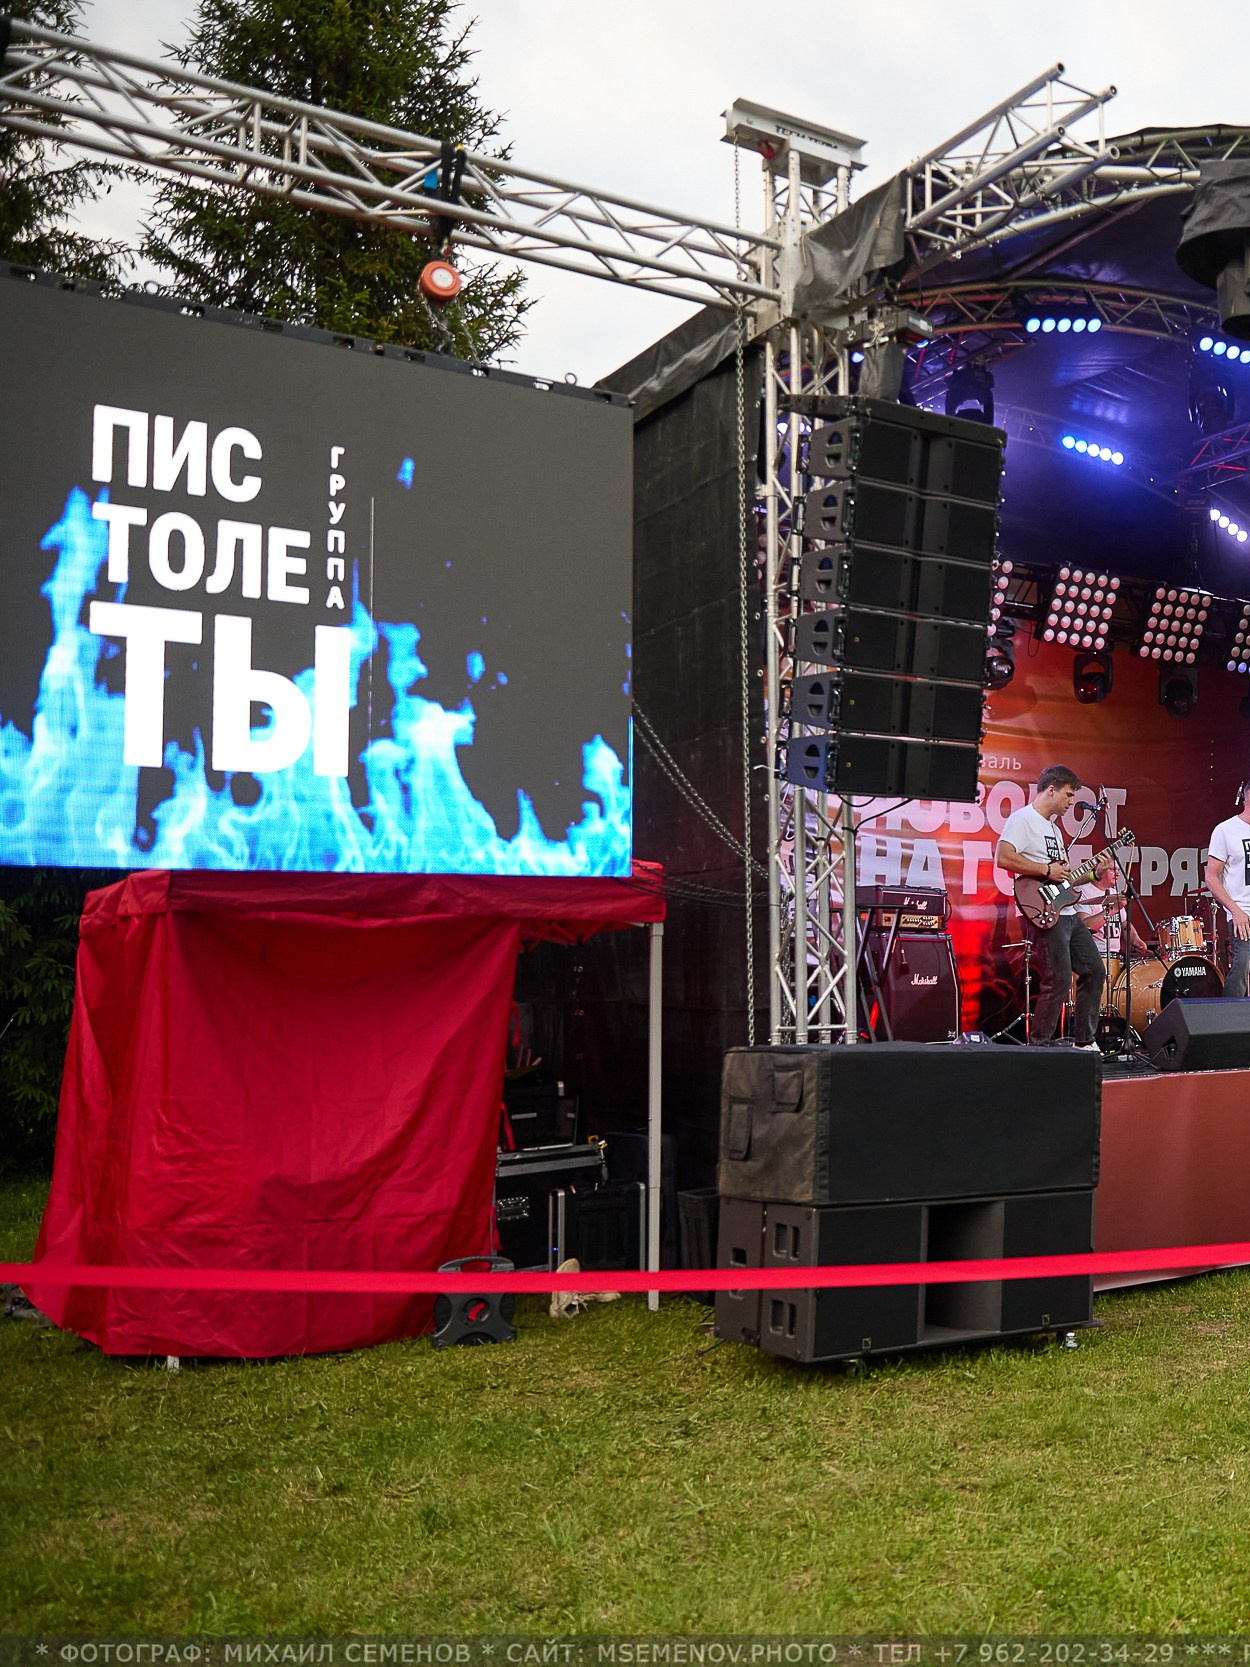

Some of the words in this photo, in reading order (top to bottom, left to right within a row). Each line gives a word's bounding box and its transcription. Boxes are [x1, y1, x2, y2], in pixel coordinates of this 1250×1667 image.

[92, 404, 262, 503] ПИС
[92, 502, 310, 604] ТОЛЕ
[325, 446, 345, 609] ГРУППА
[90, 600, 350, 777] ТЫ
[860, 836, 947, 890] НА
[910, 973, 938, 985] Marshall
[1181, 966, 1207, 977] YAMAHA
